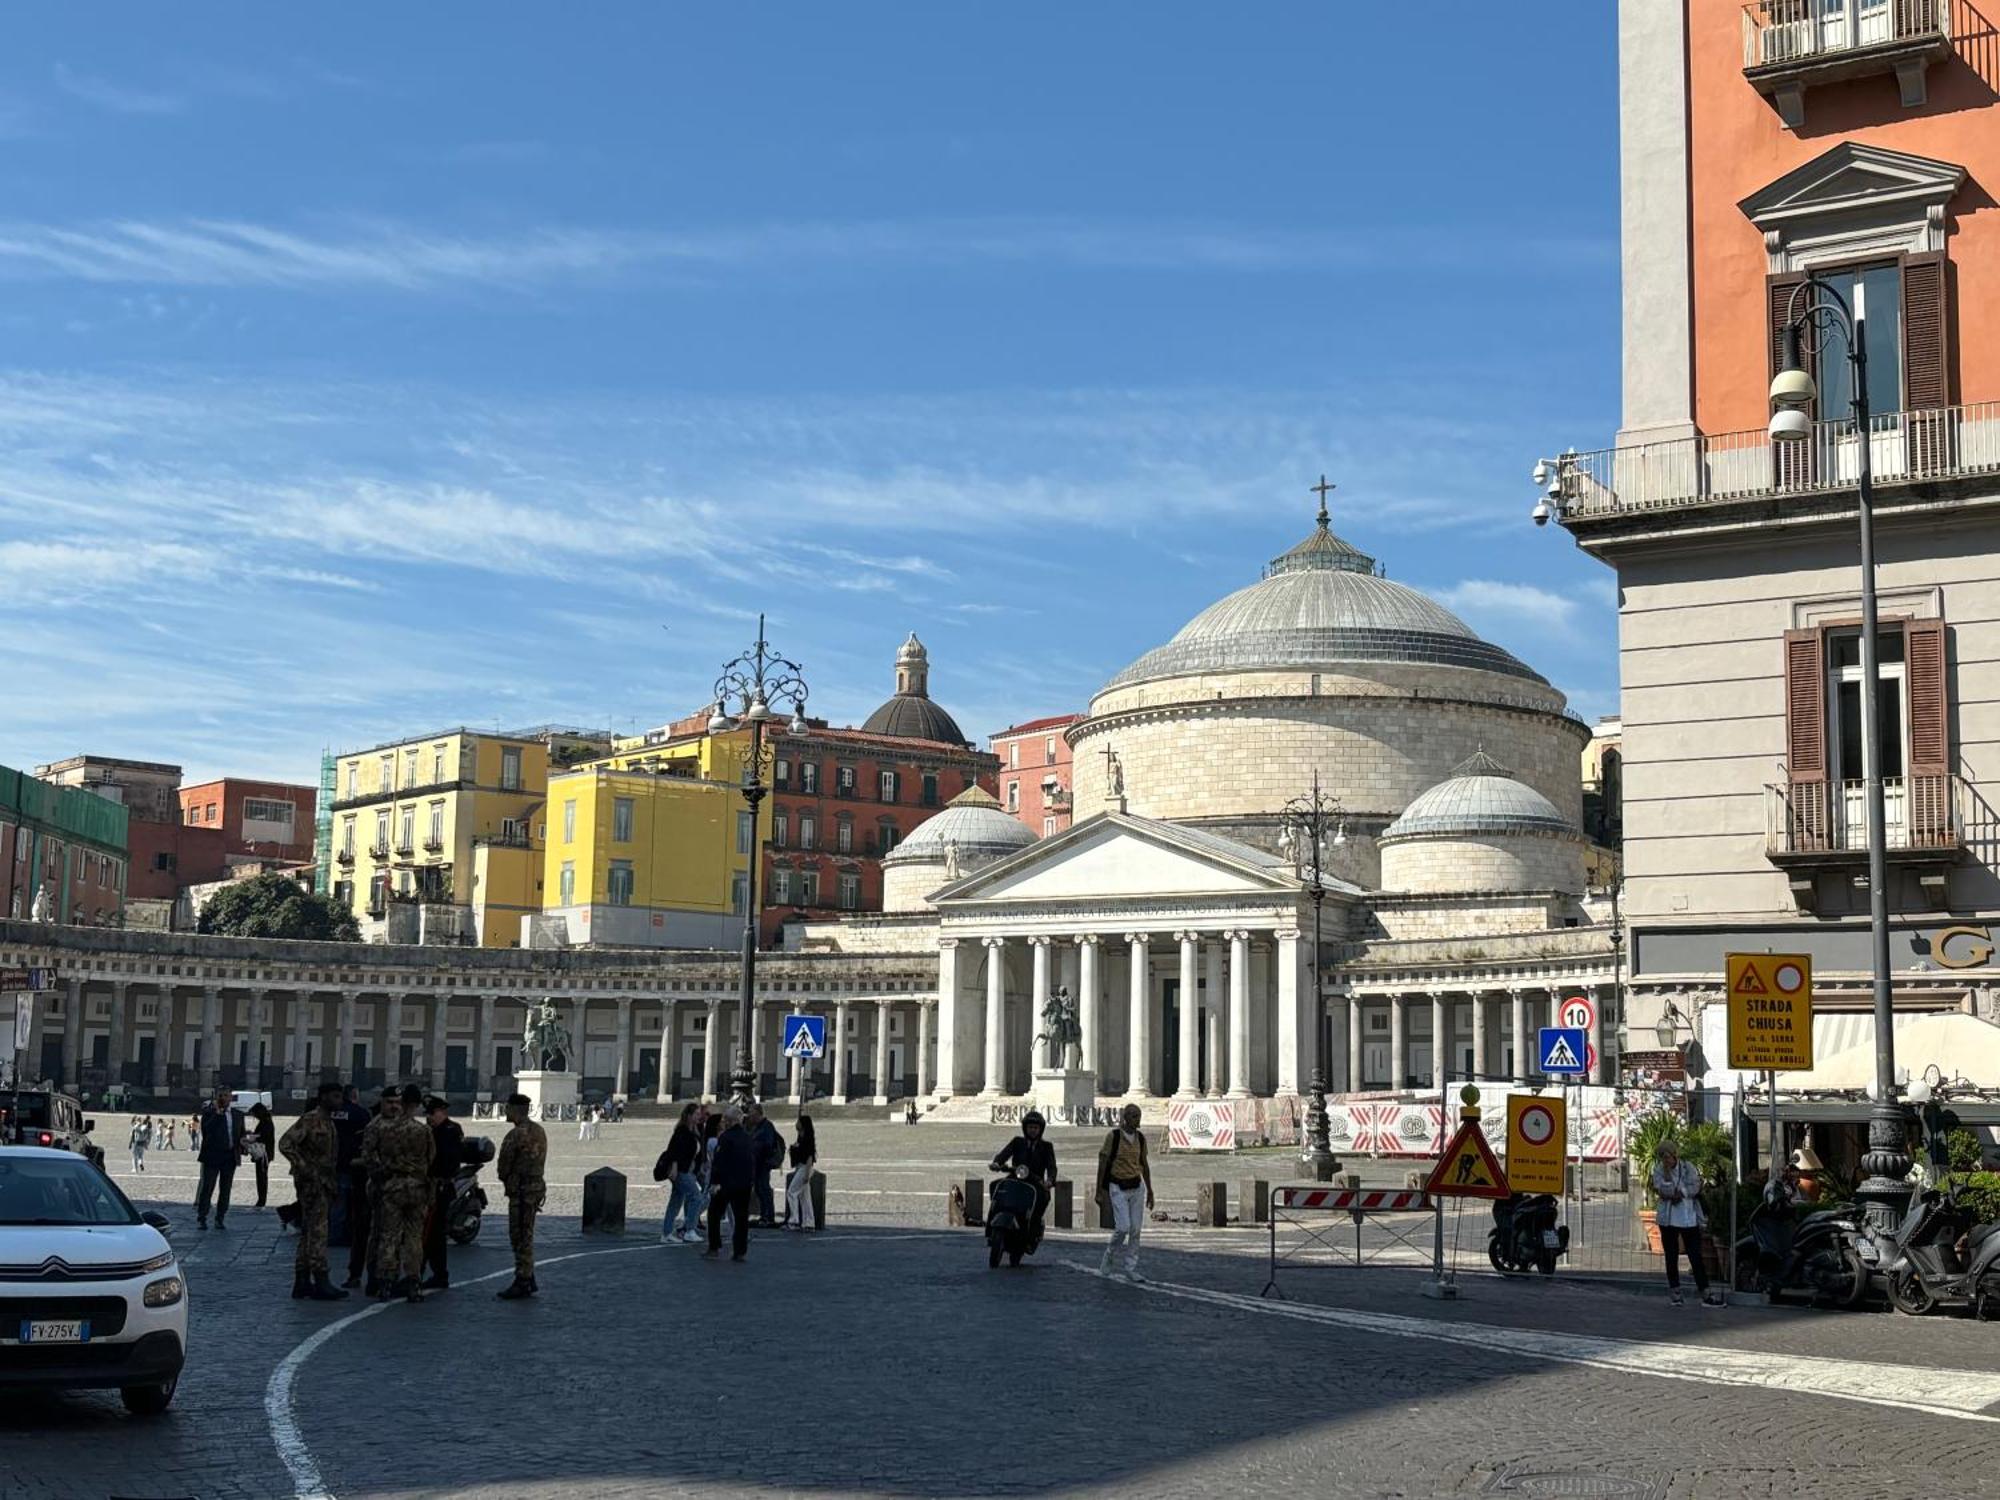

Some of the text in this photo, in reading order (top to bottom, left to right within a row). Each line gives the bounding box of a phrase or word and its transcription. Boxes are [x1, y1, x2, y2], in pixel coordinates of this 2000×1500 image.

[1931, 924, 1994, 969] G
[1746, 999, 1793, 1013] STRADA
[1566, 1008, 1586, 1026] 10
[1747, 1016, 1793, 1031] CHIUSA
